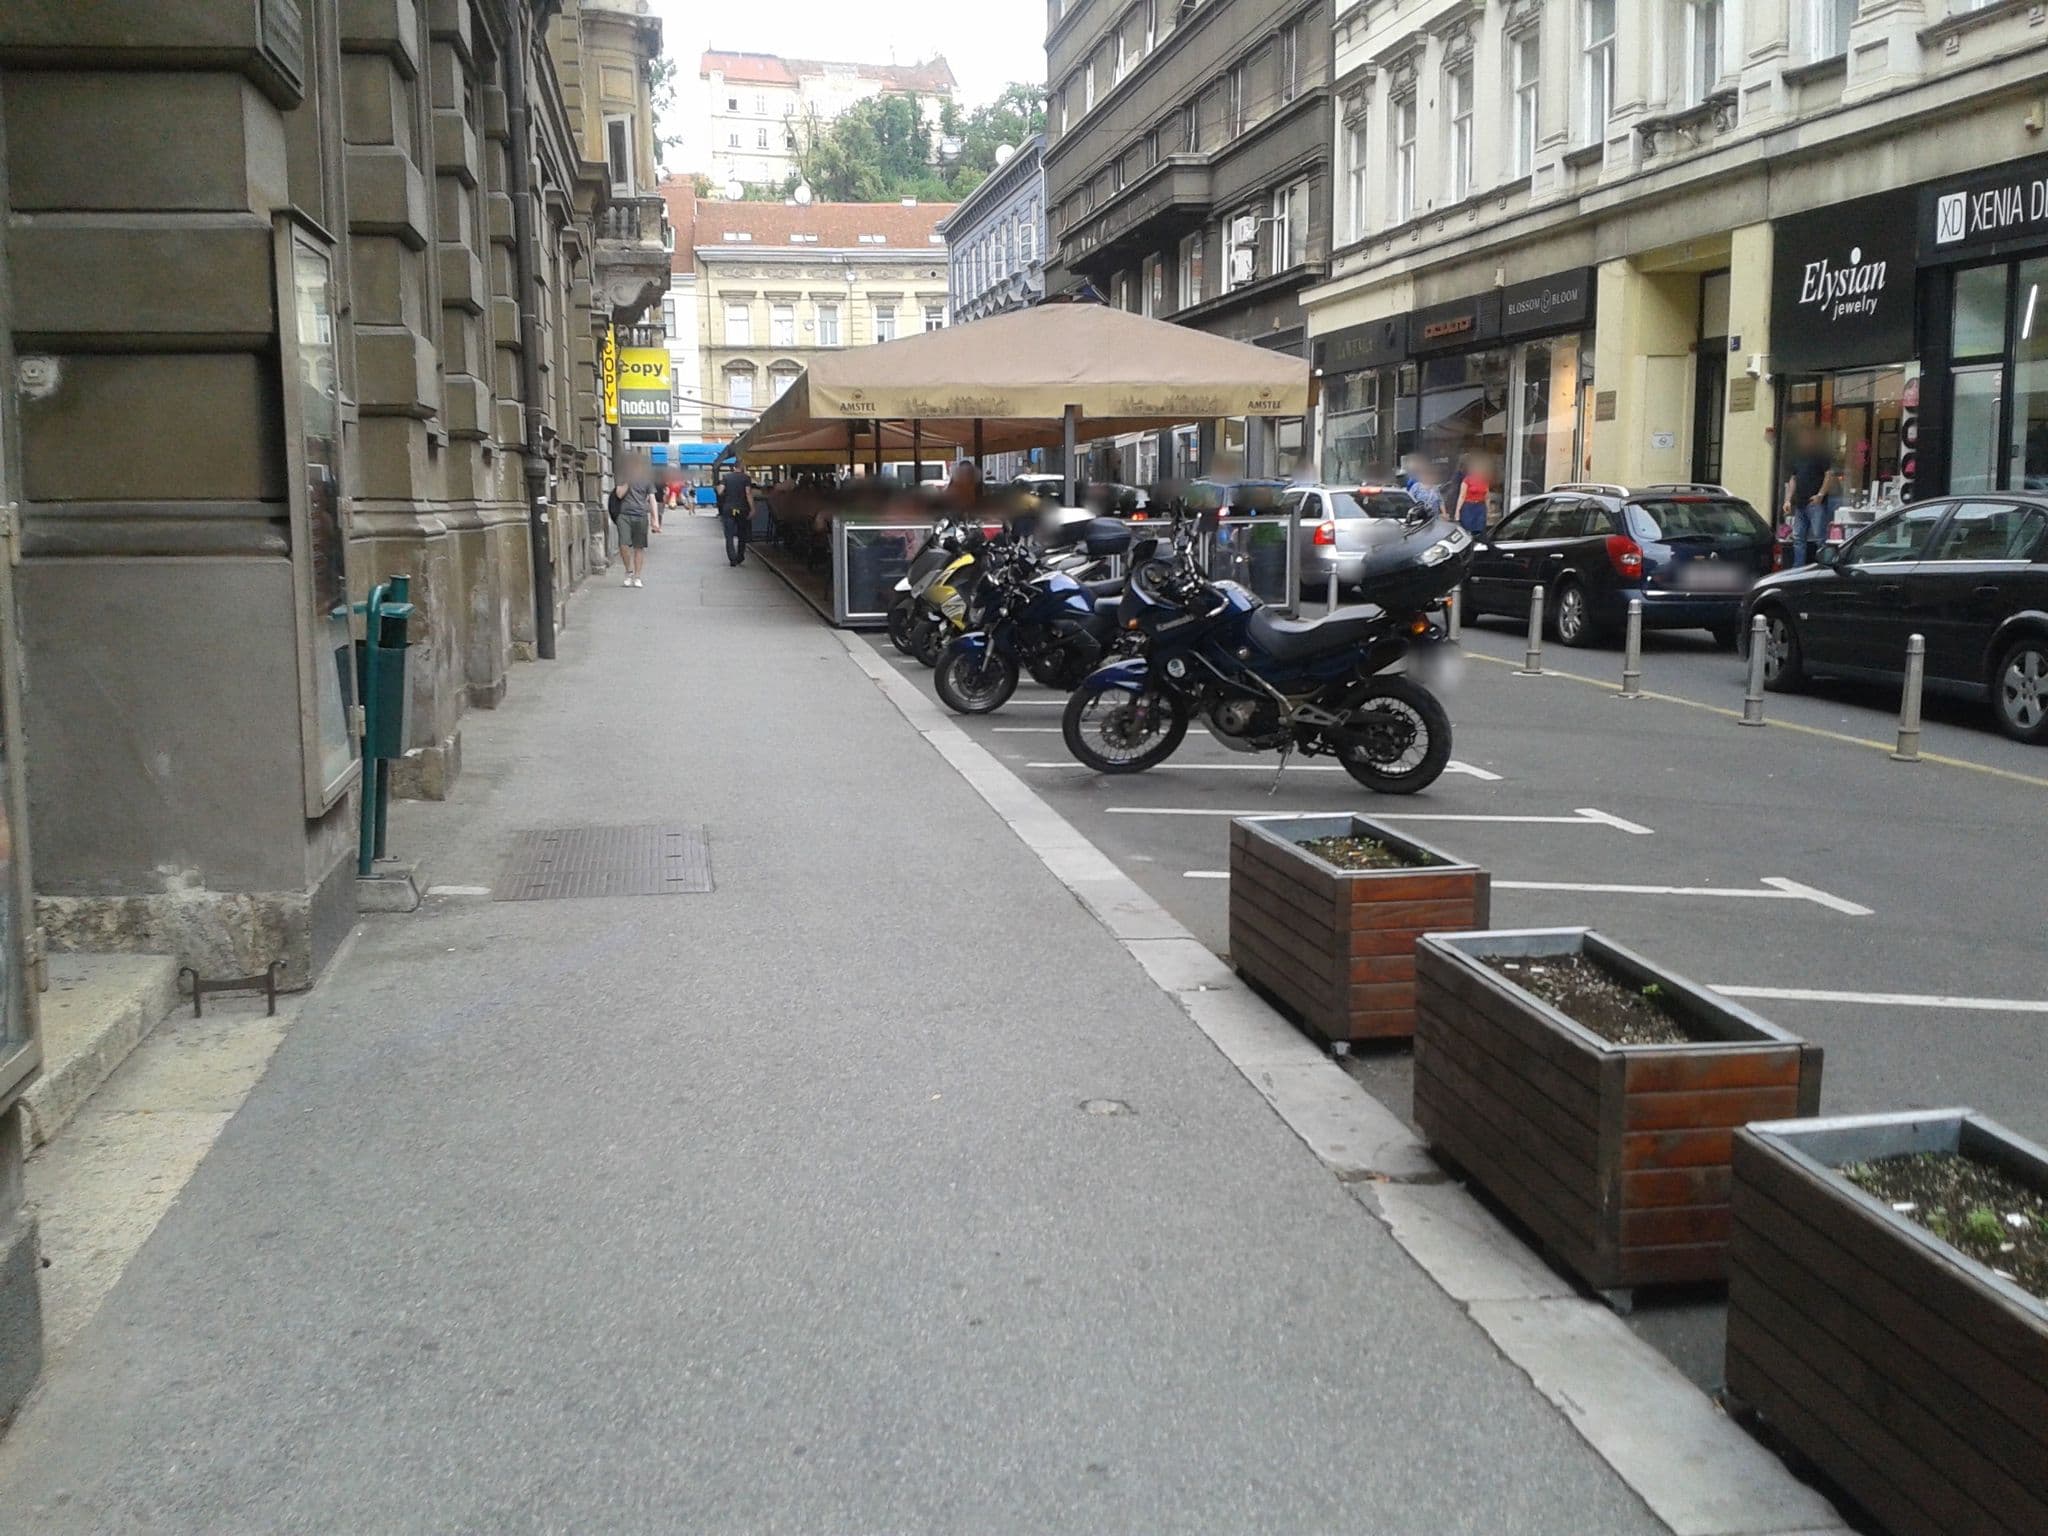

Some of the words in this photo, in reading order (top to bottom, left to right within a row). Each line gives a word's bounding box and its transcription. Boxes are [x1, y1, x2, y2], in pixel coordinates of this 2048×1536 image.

[1939, 197, 1963, 239] XD
[1970, 185, 2024, 232] XENIA
[1798, 246, 1887, 312] Elysian
[1508, 298, 1541, 315] BLOSSOM
[1551, 288, 1578, 305] BLOOM
[1832, 294, 1878, 321] jewelry
[621, 362, 663, 377] copy
[839, 402, 876, 412] AMSTEL
